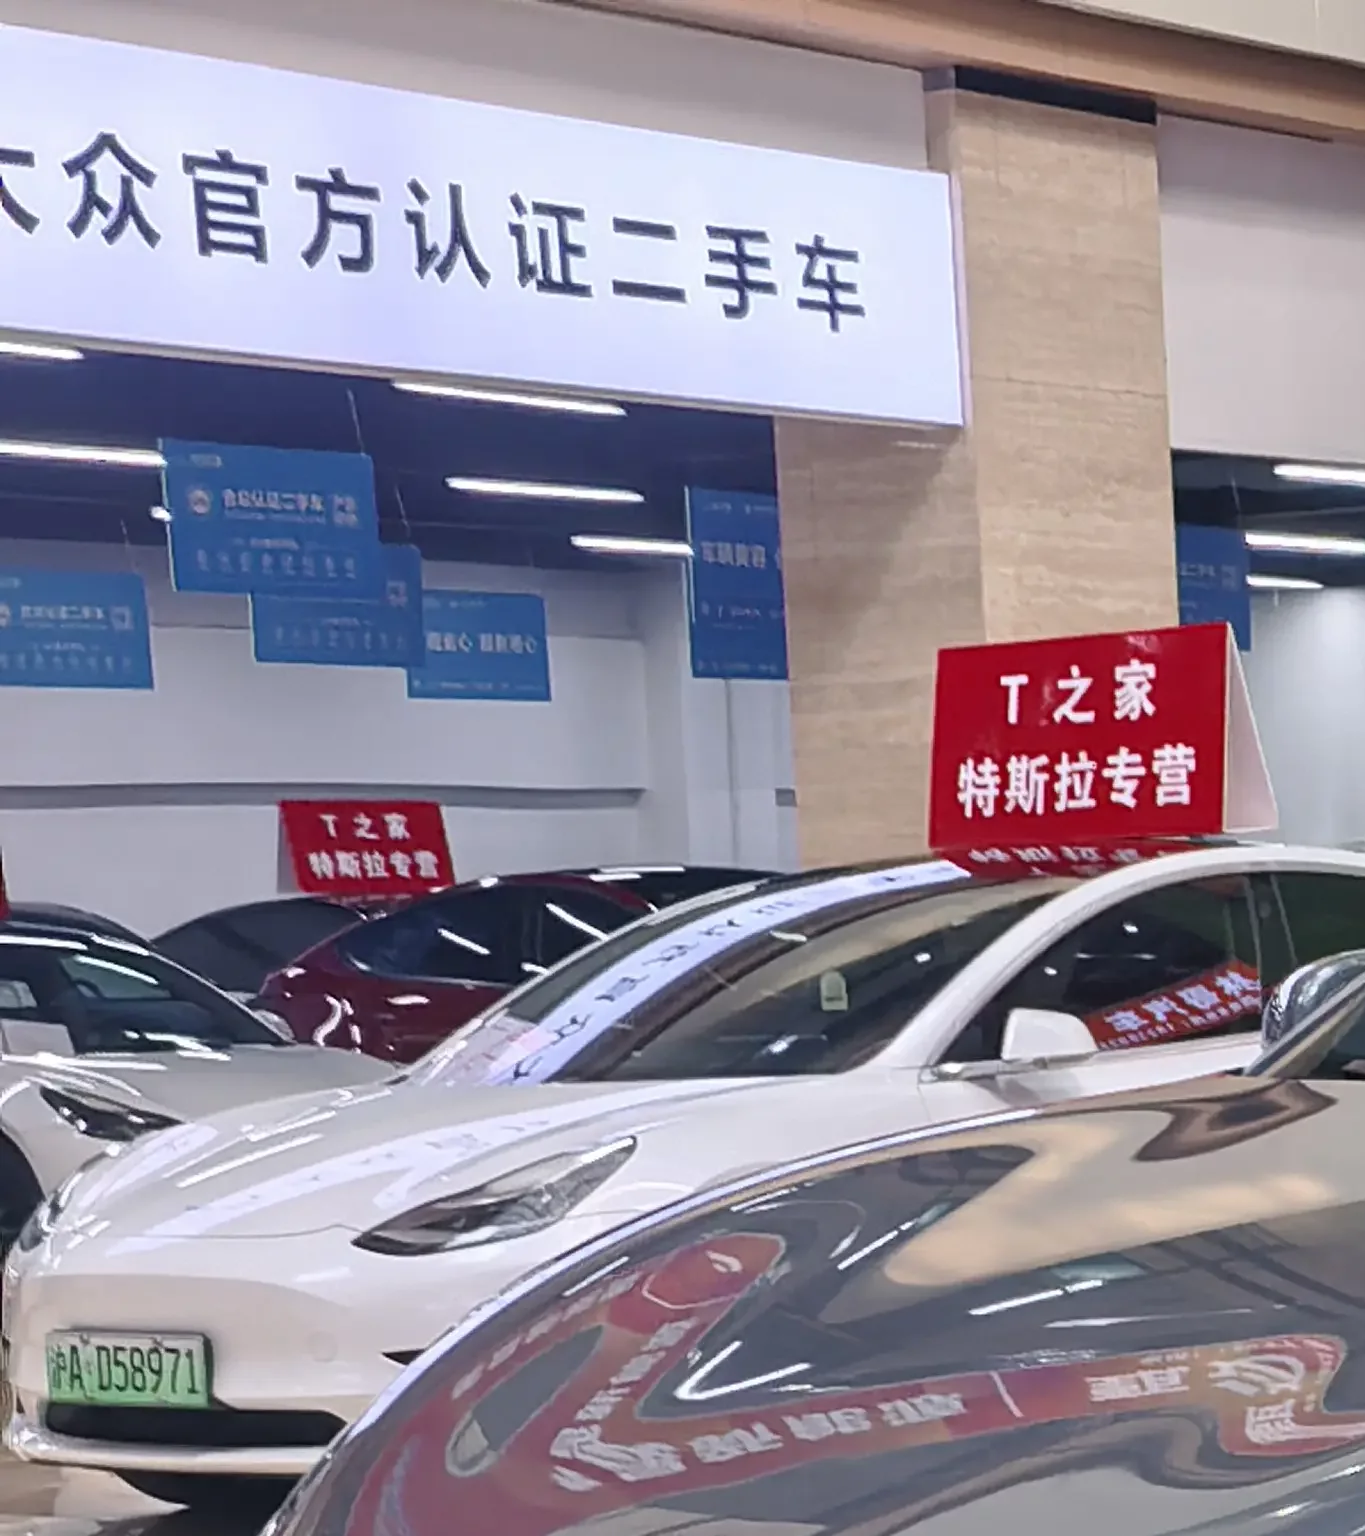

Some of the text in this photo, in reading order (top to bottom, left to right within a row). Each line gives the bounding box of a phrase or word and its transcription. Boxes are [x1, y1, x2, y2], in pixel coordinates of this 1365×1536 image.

[956, 744, 1197, 818] 特斯拉专营
[308, 849, 440, 880] 特斯拉专营
